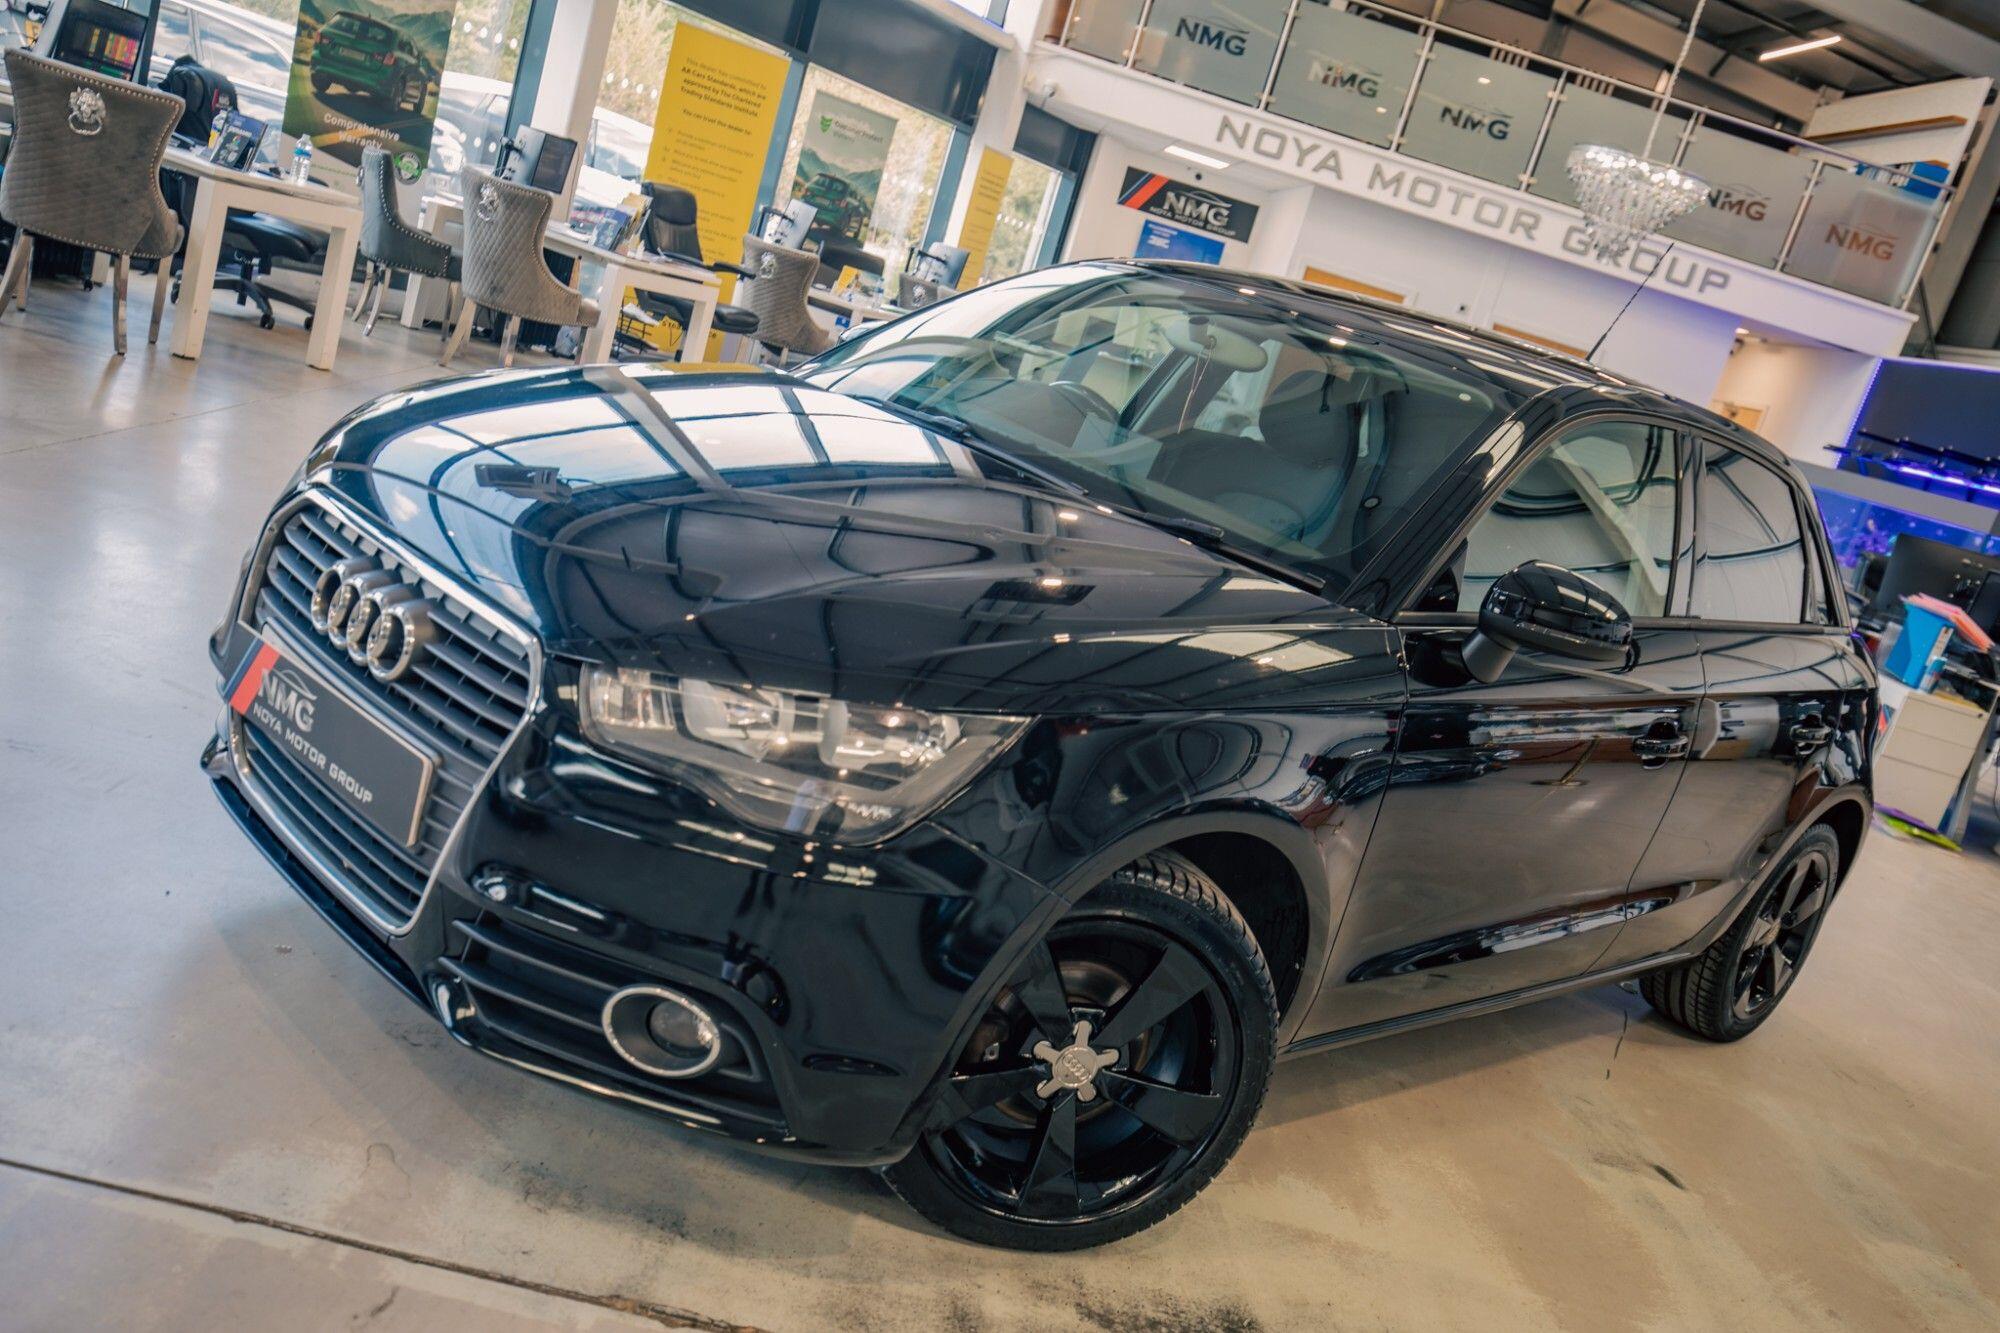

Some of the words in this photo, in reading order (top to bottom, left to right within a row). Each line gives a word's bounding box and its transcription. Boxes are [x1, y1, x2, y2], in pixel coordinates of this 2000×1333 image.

[1175, 17, 1247, 56] NMG
[324, 113, 400, 142] Comprehensive
[339, 132, 383, 149] Warranty
[1440, 106, 1511, 140] NMG
[1216, 115, 1344, 181] NOYA
[1367, 163, 1543, 241] MOTOR
[1163, 191, 1230, 227] NMG
[1825, 224, 1896, 260] NMG
[258, 669, 315, 732] NMG
[253, 703, 282, 735] NOYA
[285, 728, 327, 769] MOTOR
[329, 763, 373, 803] GROUP
